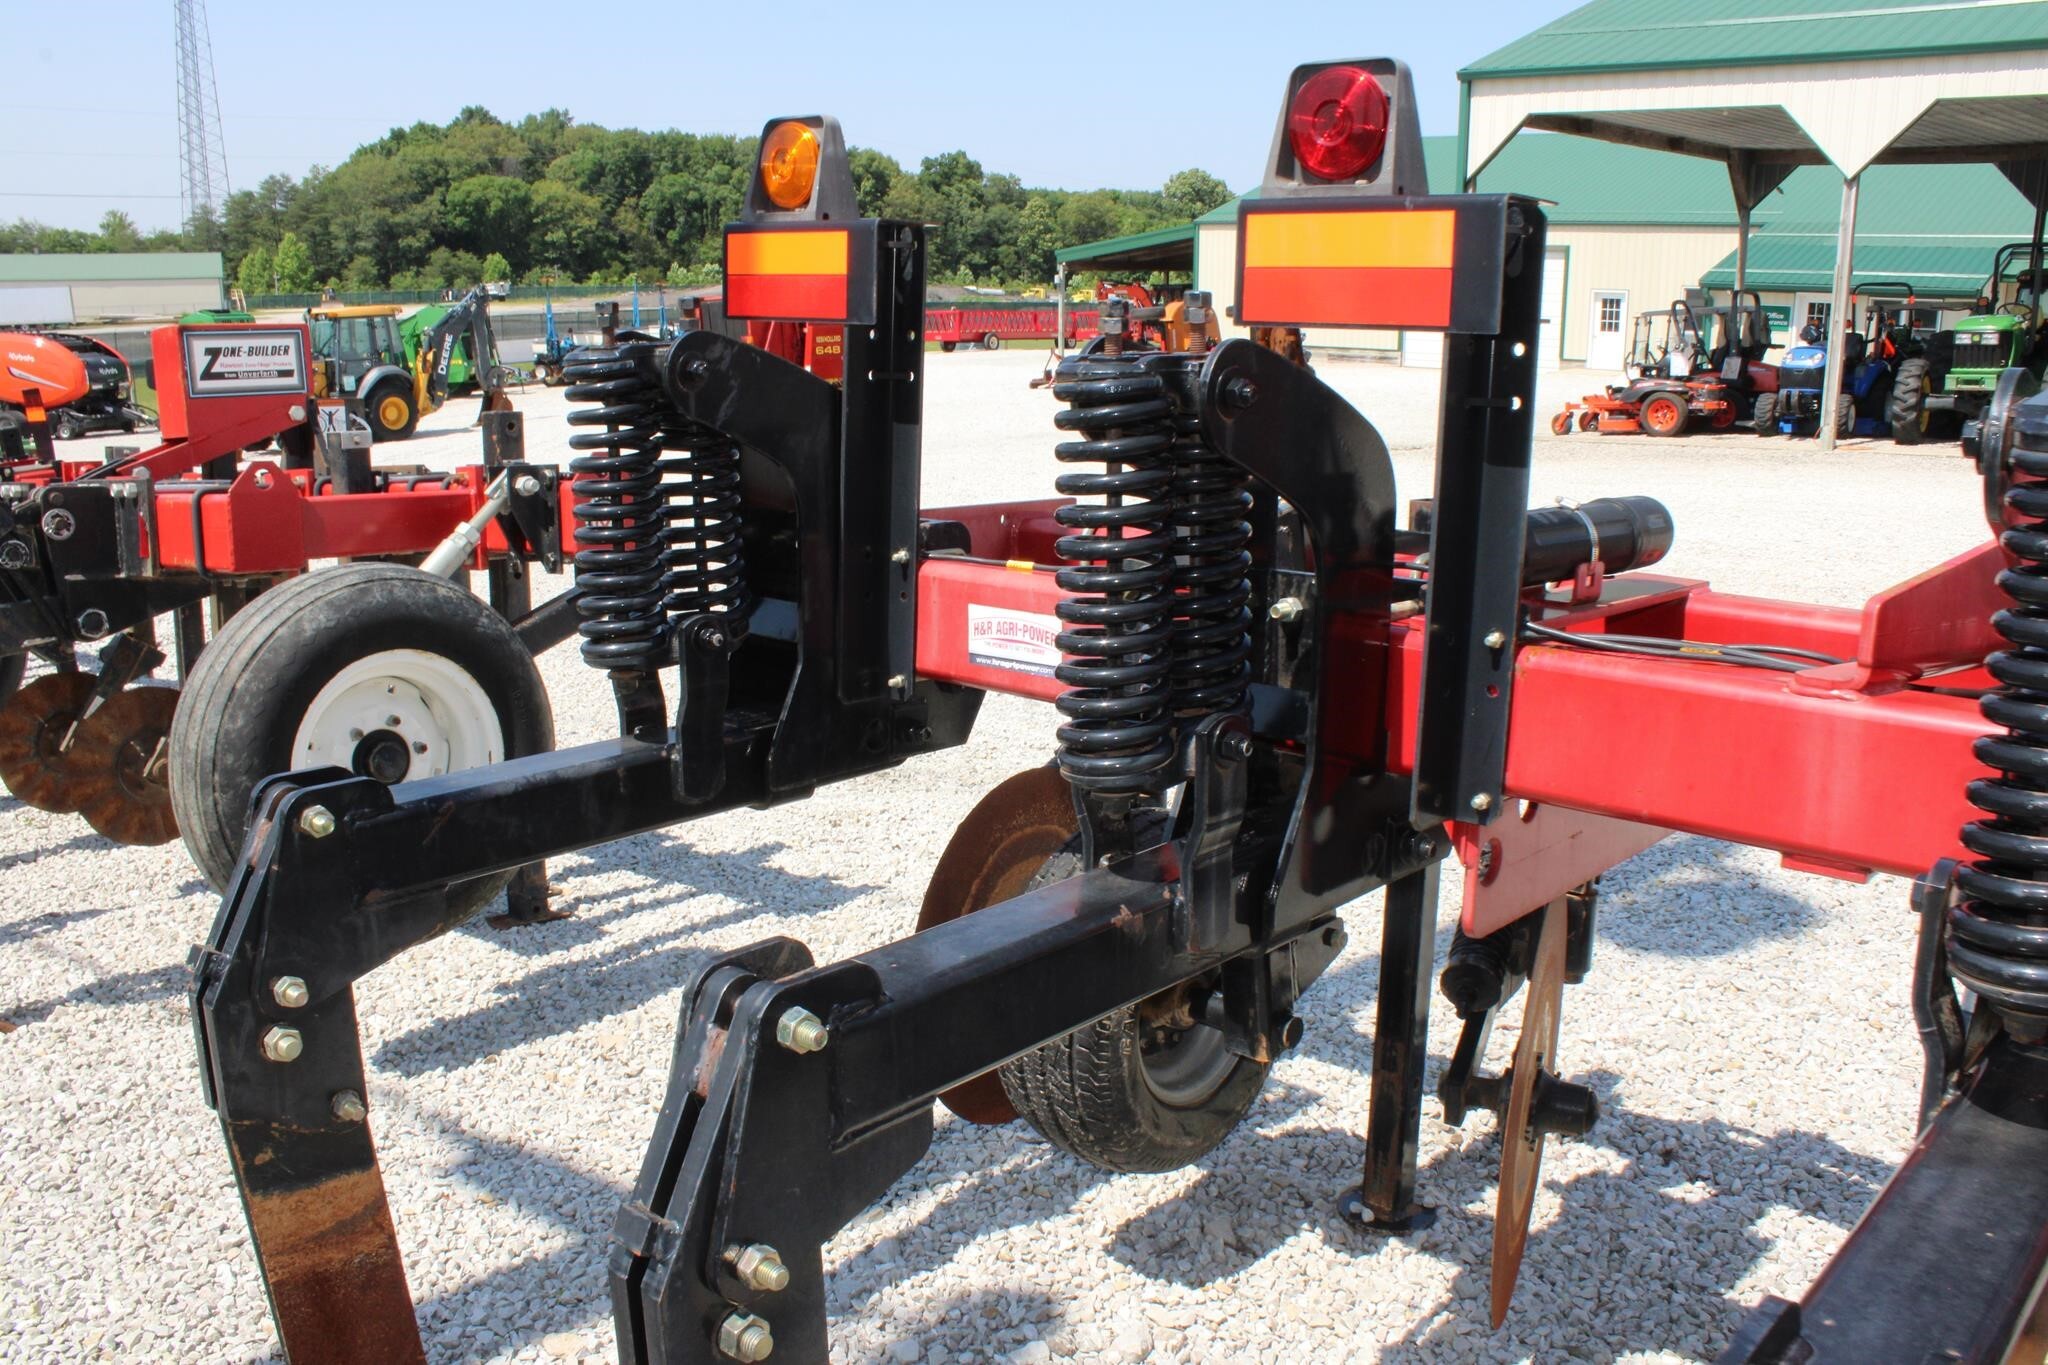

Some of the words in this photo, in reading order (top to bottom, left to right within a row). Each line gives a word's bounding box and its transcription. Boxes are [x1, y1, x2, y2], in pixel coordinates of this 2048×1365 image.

[438, 333, 453, 375] DEERE
[816, 345, 841, 355] 648
[8, 352, 35, 362] Kubota
[974, 621, 993, 637] H&R
